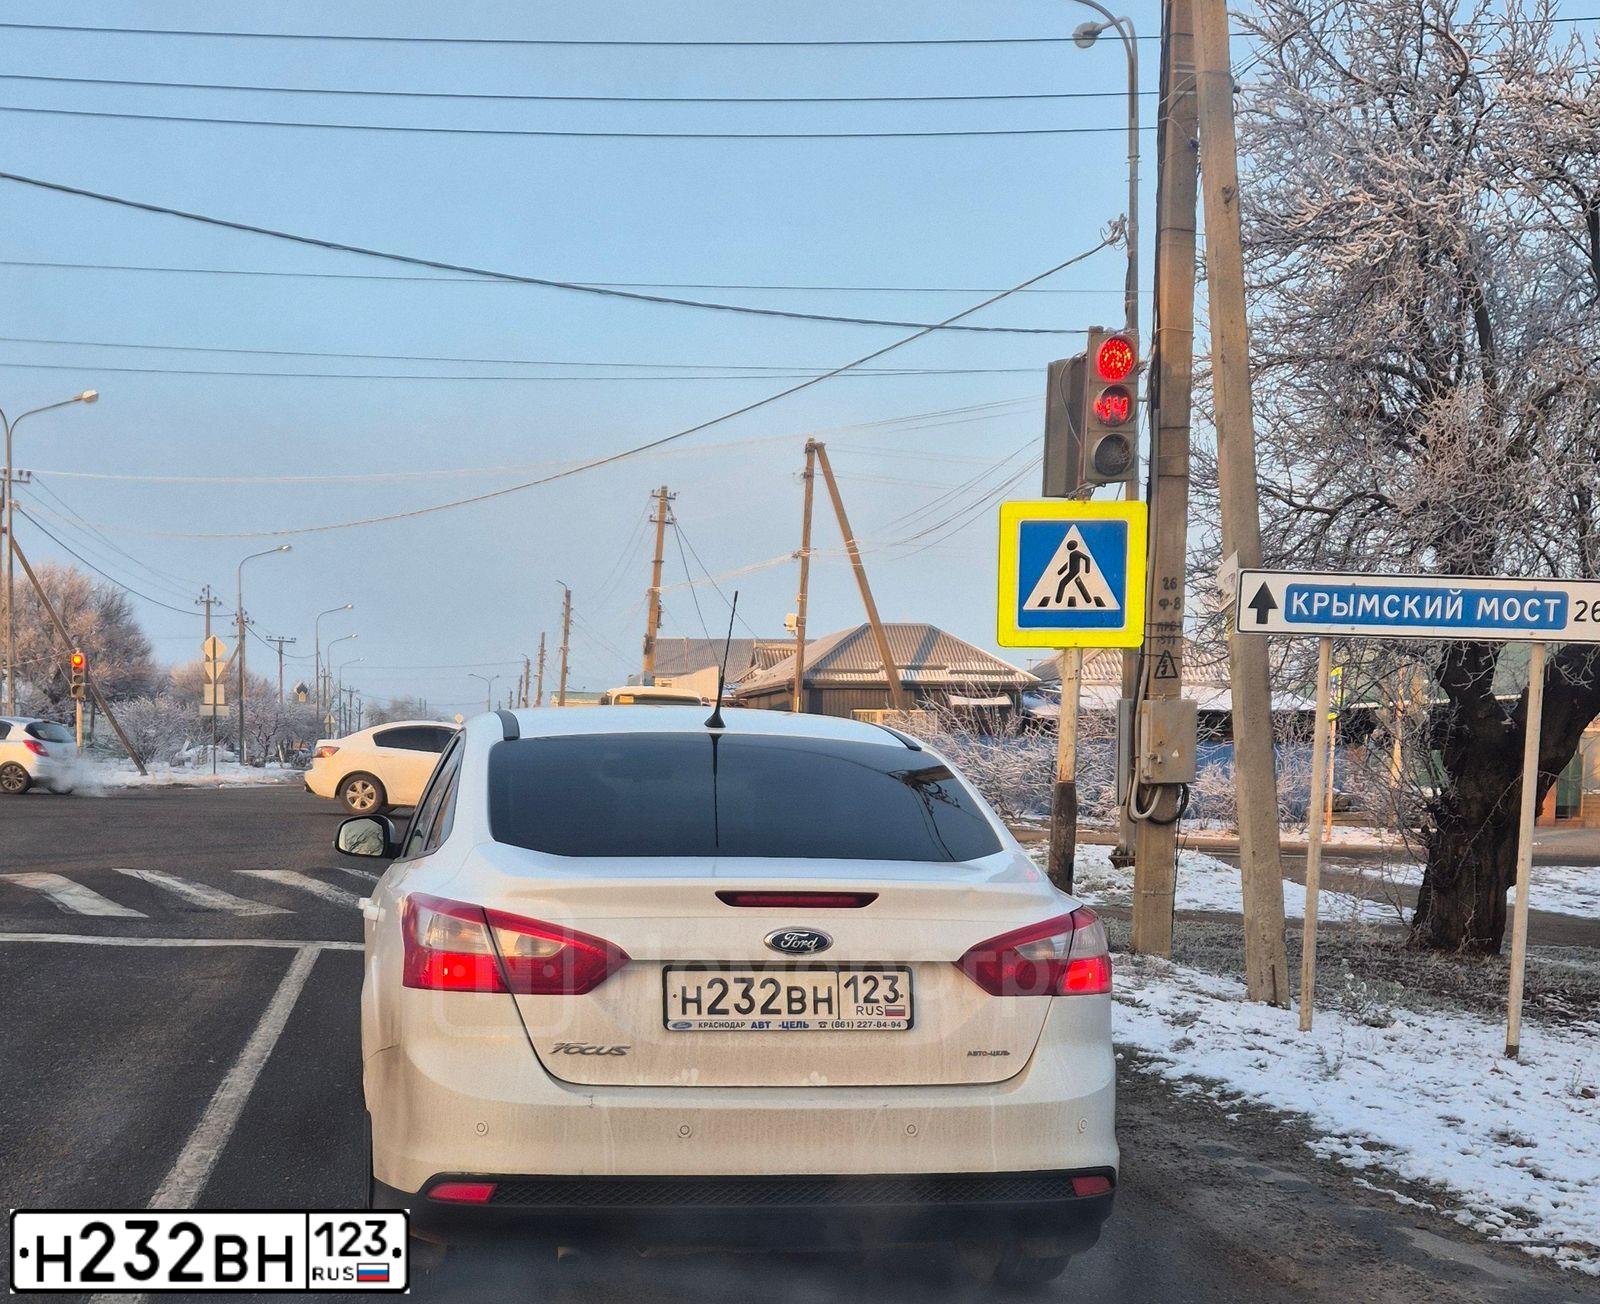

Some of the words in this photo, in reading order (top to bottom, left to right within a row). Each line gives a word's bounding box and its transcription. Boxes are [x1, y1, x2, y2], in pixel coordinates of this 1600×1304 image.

[1292, 589, 1464, 620] КРЫМСКИЙ
[1476, 597, 1561, 622] МОСТ
[780, 932, 818, 948] Ford
[843, 975, 900, 1003] 123
[856, 1005, 883, 1016] RUS
[698, 1021, 746, 1029] КРАСНОДАР
[831, 1021, 854, 1030] (861)
